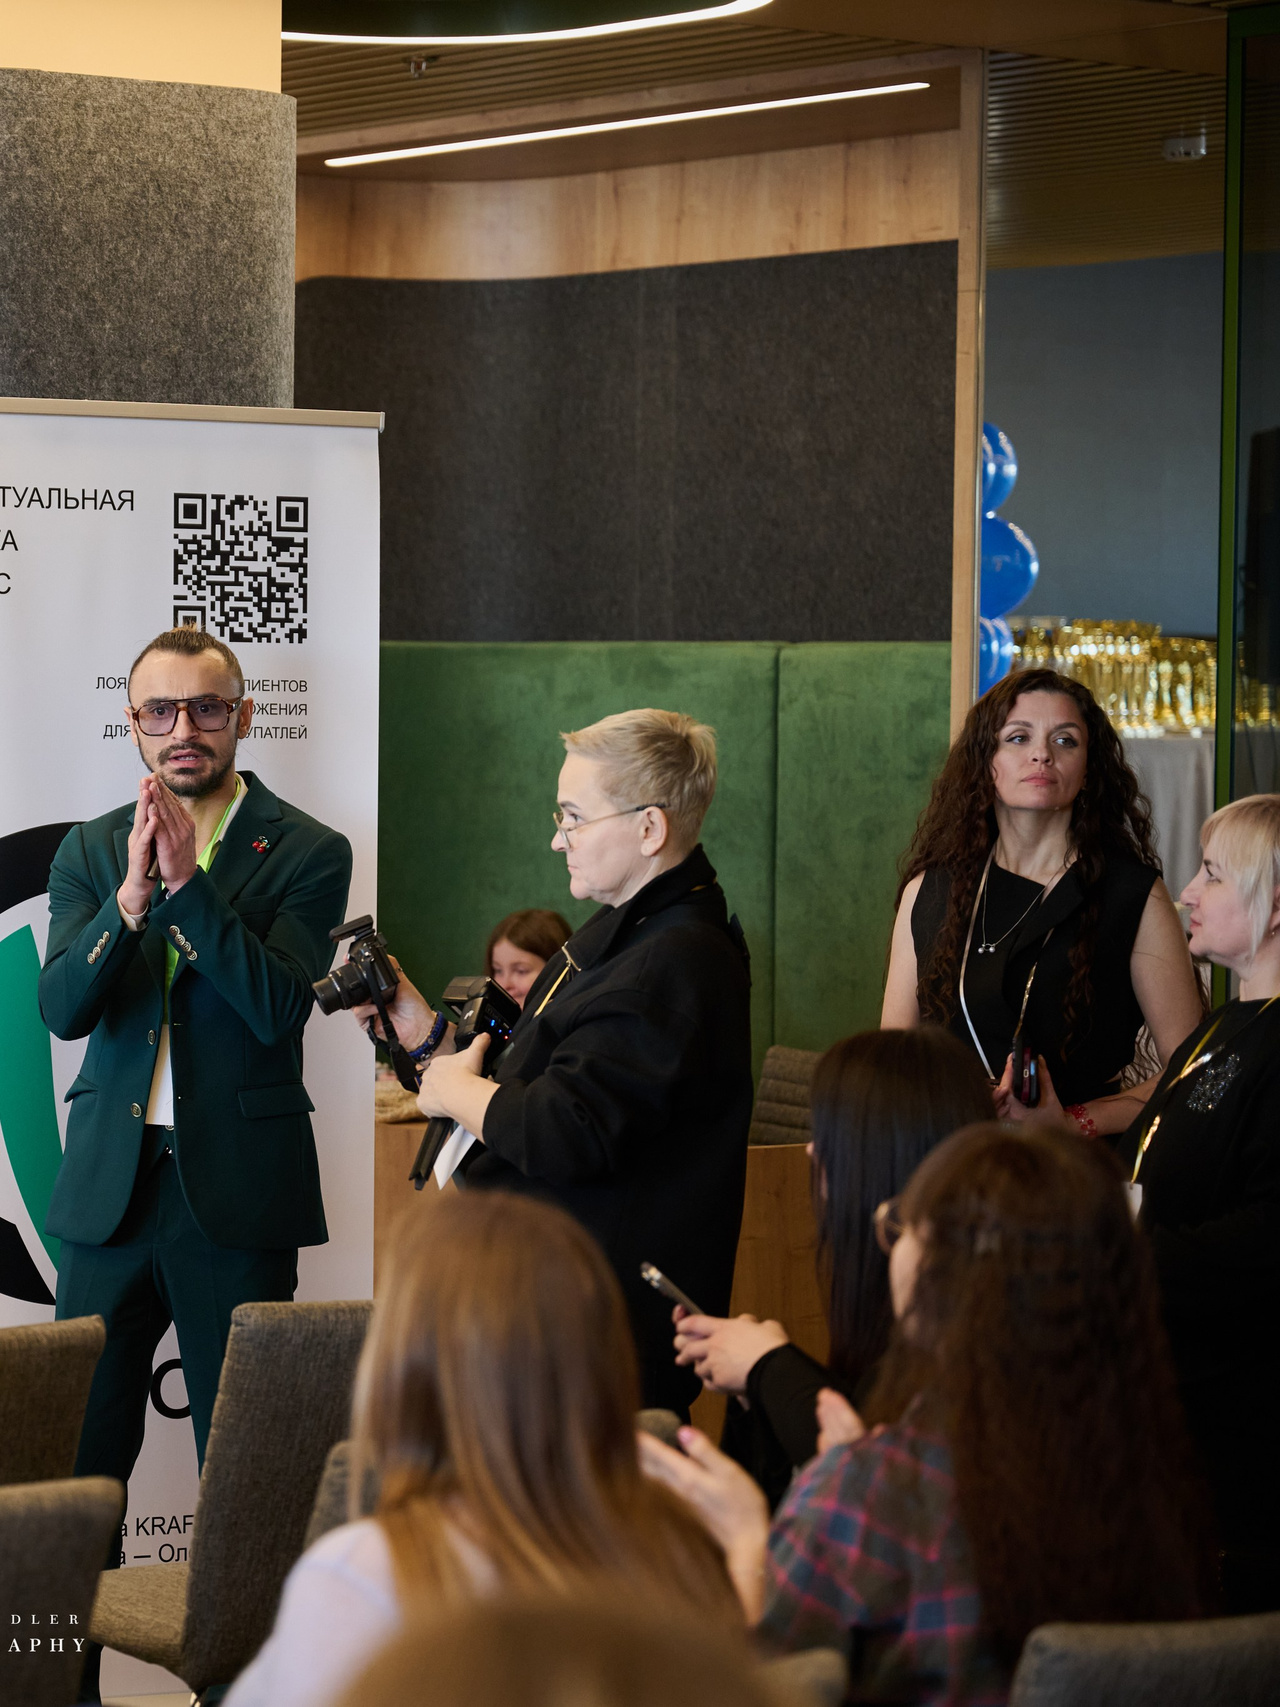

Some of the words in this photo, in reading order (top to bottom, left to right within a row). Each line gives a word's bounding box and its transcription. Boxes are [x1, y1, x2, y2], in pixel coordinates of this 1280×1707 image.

[95, 676, 127, 689] ЛОЯ
[136, 1514, 195, 1537] KRAF
[158, 1543, 192, 1562] Ол
